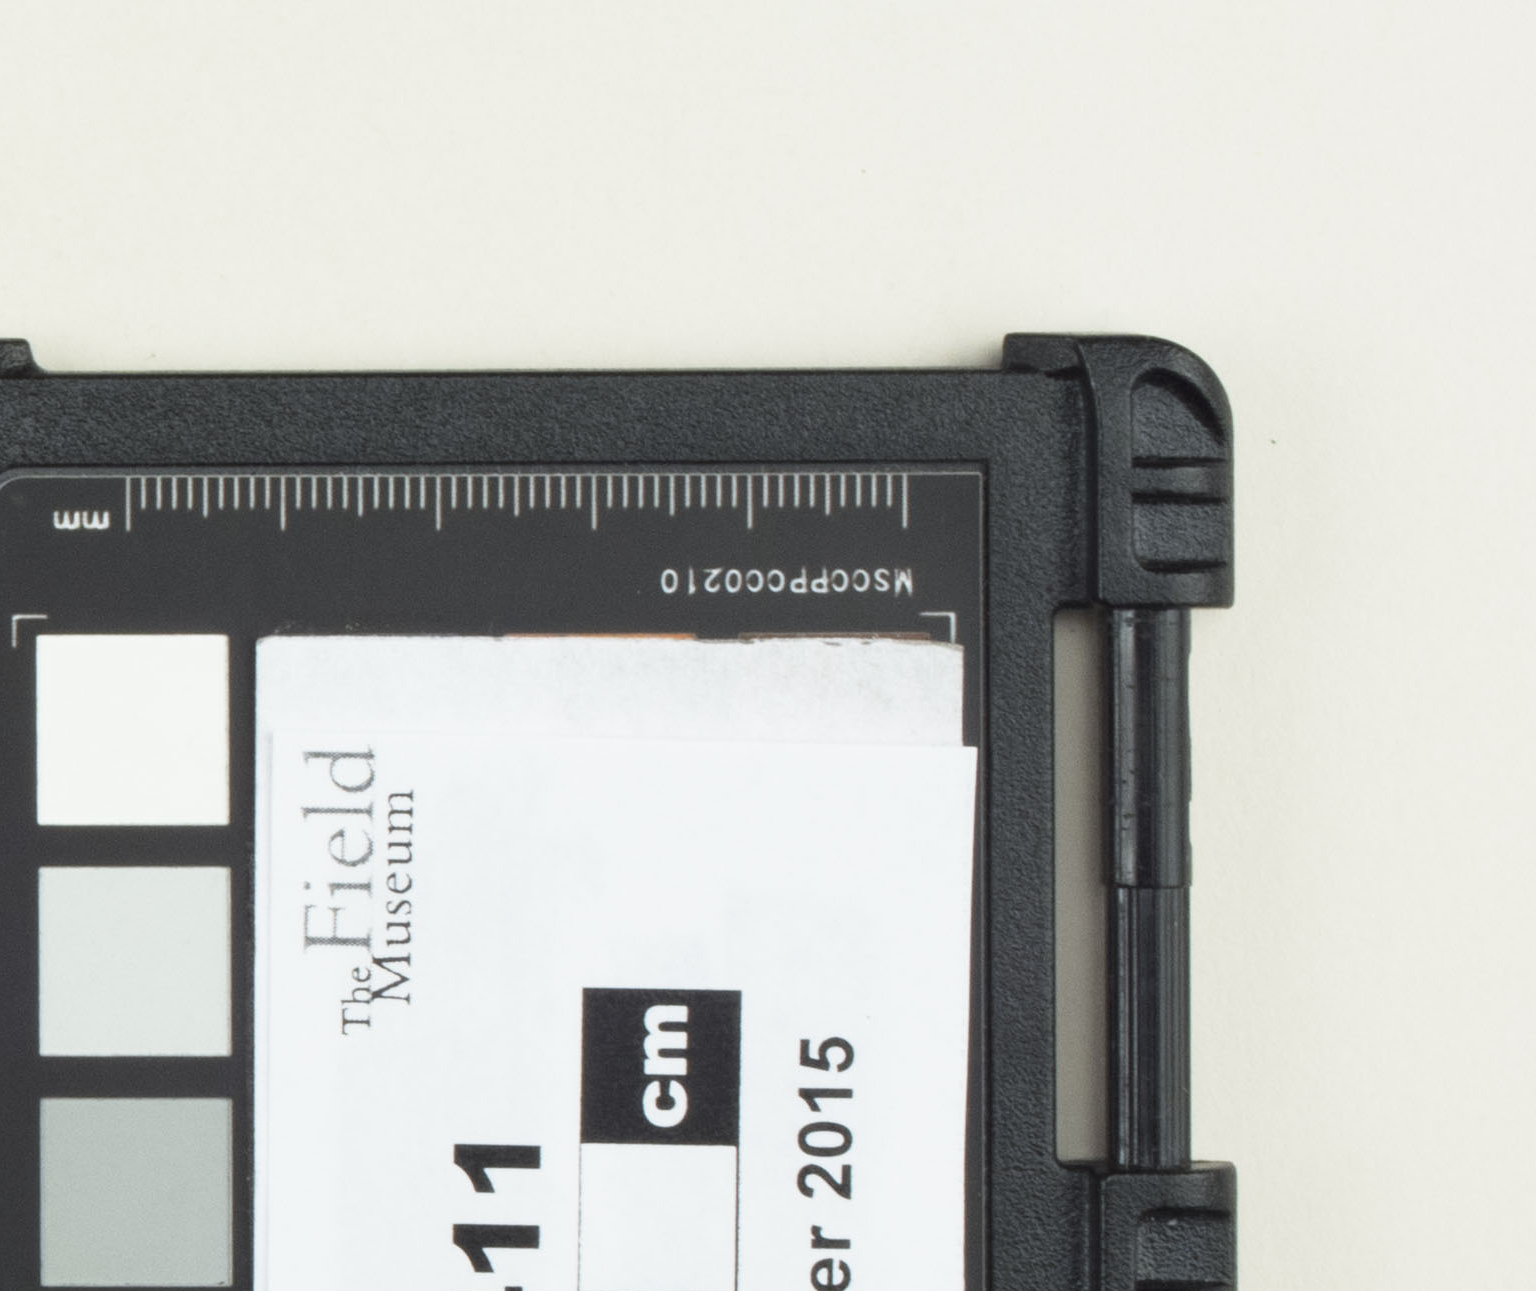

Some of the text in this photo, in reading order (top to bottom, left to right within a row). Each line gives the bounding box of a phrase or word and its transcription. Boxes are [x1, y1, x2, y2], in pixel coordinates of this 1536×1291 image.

[53, 510, 110, 532] mm
[660, 567, 914, 597] MSCCPPCC0210
[301, 746, 375, 1034] The Field
[371, 790, 414, 1004] Museum
[642, 1004, 689, 1128] cm
[797, 1037, 854, 1200] 2015
